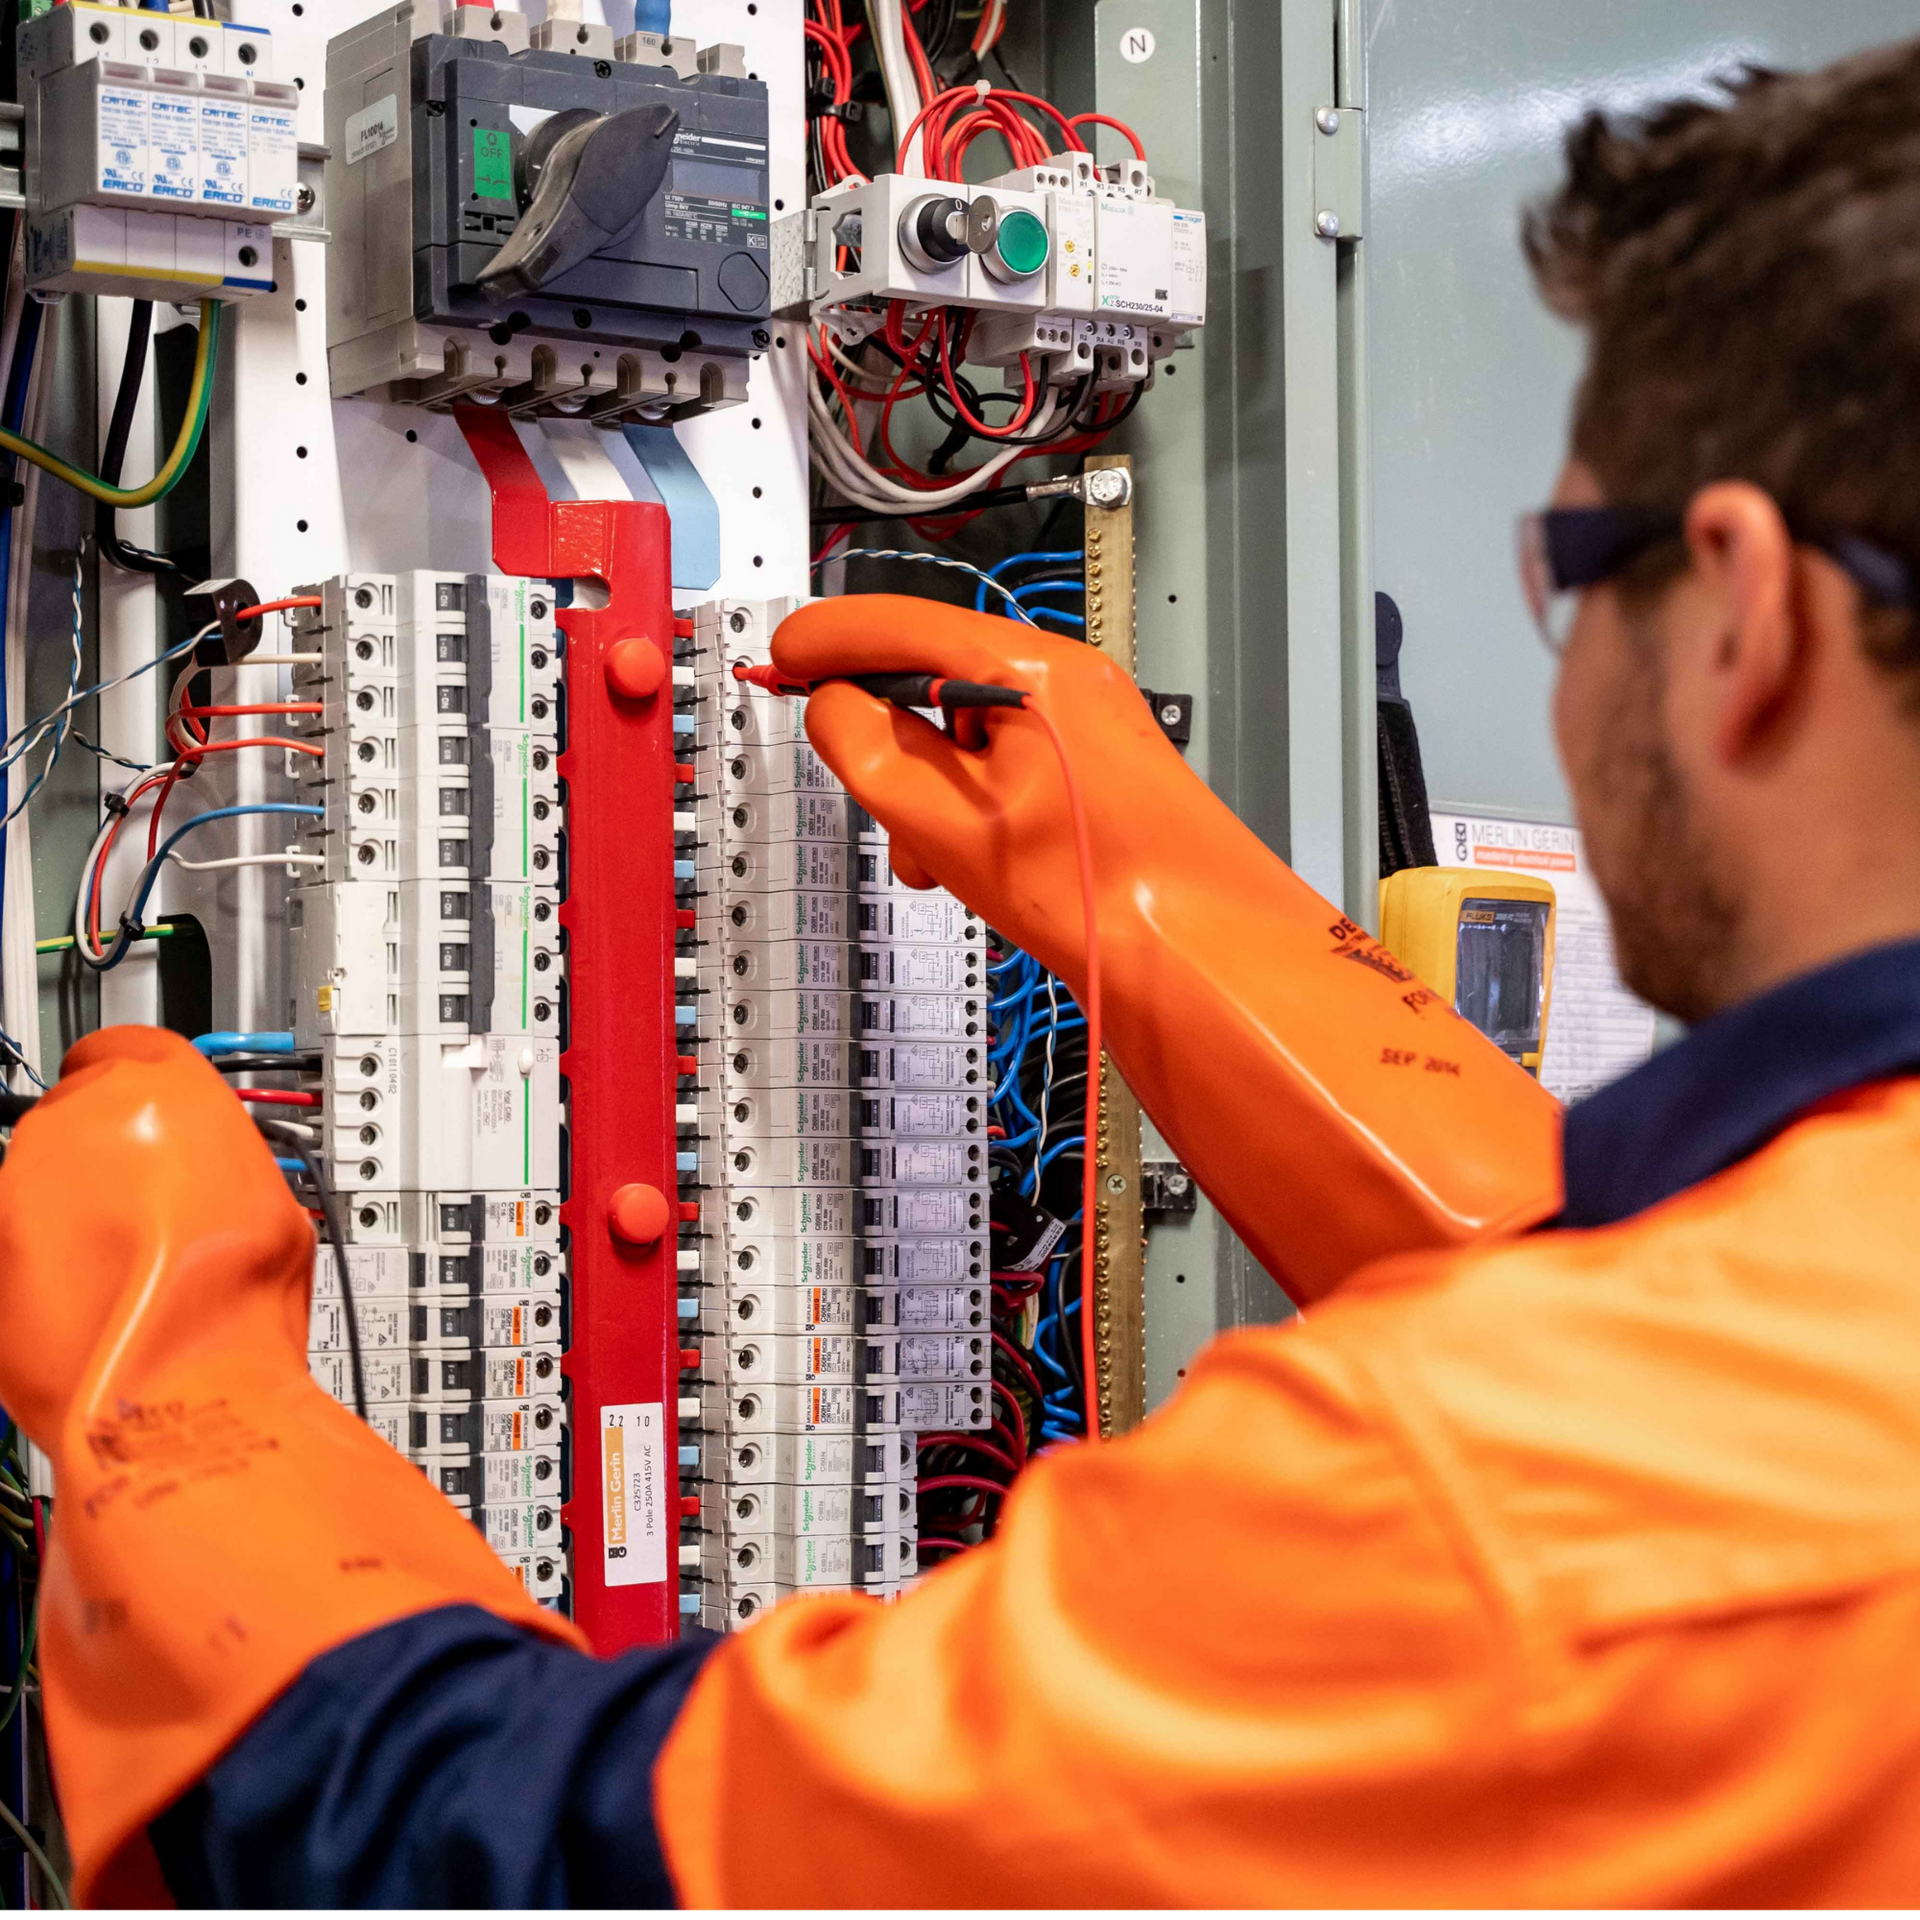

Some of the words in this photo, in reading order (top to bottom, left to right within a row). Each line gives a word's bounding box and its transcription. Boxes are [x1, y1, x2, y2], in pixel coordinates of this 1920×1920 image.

[642, 36, 656, 46] 160
[1129, 35, 1146, 55] N
[102, 95, 142, 108] CRITEC
[152, 102, 192, 114] CRITEC
[202, 108, 242, 120] CRITEC
[252, 115, 291, 127] CRITEC
[480, 146, 502, 159] OFF
[102, 179, 144, 193] ERICO
[152, 185, 194, 198] ERICO
[203, 189, 244, 204] ERICO
[252, 197, 292, 210] ERICO
[237, 227, 252, 238] PE
[794, 698, 804, 738] Schneider
[517, 733, 530, 778] Schneider
[794, 747, 805, 788] Schneider
[796, 796, 807, 837] Schneider
[1471, 823, 1528, 848] MERLIN
[1531, 829, 1576, 852] GERIN
[797, 844, 807, 885] Schneider
[518, 885, 531, 929] Schneider
[796, 894, 807, 935] Schneider
[1465, 913, 1493, 921] FLUKE
[798, 943, 809, 984] Schneider
[797, 992, 809, 1033] Schneider
[797, 1041, 809, 1083] Schneider
[797, 1092, 809, 1134] Schneider
[798, 1141, 809, 1183] Schneider
[800, 1192, 812, 1233] Schneider
[521, 1246, 533, 1288] Schneider
[801, 1241, 812, 1283] Schneider
[323, 1304, 329, 1312] L
[322, 1341, 329, 1349] N
[325, 1357, 332, 1365] L
[636, 1415, 650, 1427] 10
[644, 1445, 652, 1457] AC
[805, 1439, 816, 1480] Schneider
[521, 1455, 533, 1497] Schneider
[609, 1452, 621, 1492] Gerin
[644, 1460, 652, 1483] 415V
[633, 1472, 642, 1512] C325723
[645, 1484, 653, 1507] 250A
[803, 1489, 814, 1532] Schneider
[522, 1504, 534, 1548] Schneider
[610, 1496, 623, 1541] Merlin
[645, 1510, 653, 1528] Pole
[805, 1539, 816, 1582] Schneider
